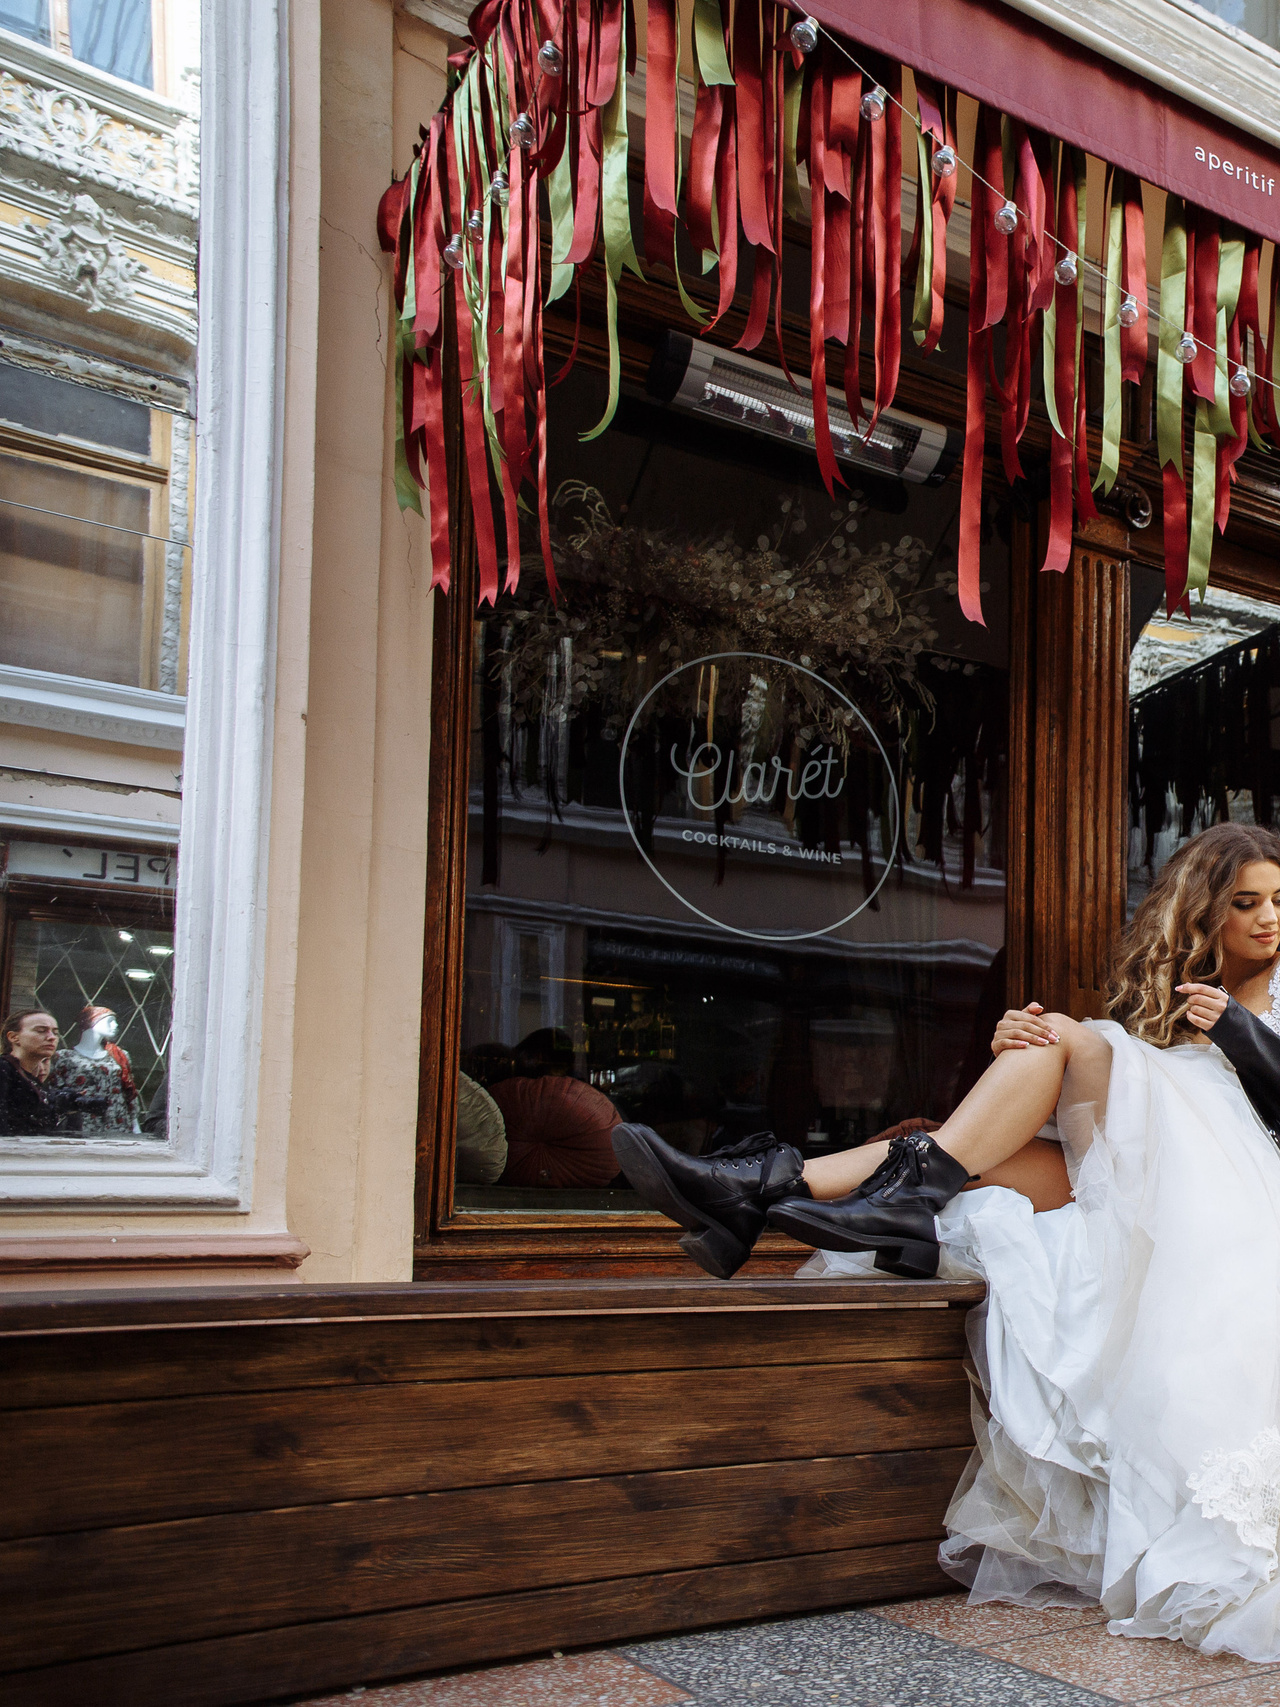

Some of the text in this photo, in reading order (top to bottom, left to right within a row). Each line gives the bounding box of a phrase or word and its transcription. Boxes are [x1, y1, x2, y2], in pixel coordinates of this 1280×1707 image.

[1194, 146, 1276, 196] aperitif
[670, 742, 845, 811] Clarét
[681, 829, 843, 865] COCKTAILS & WINE
